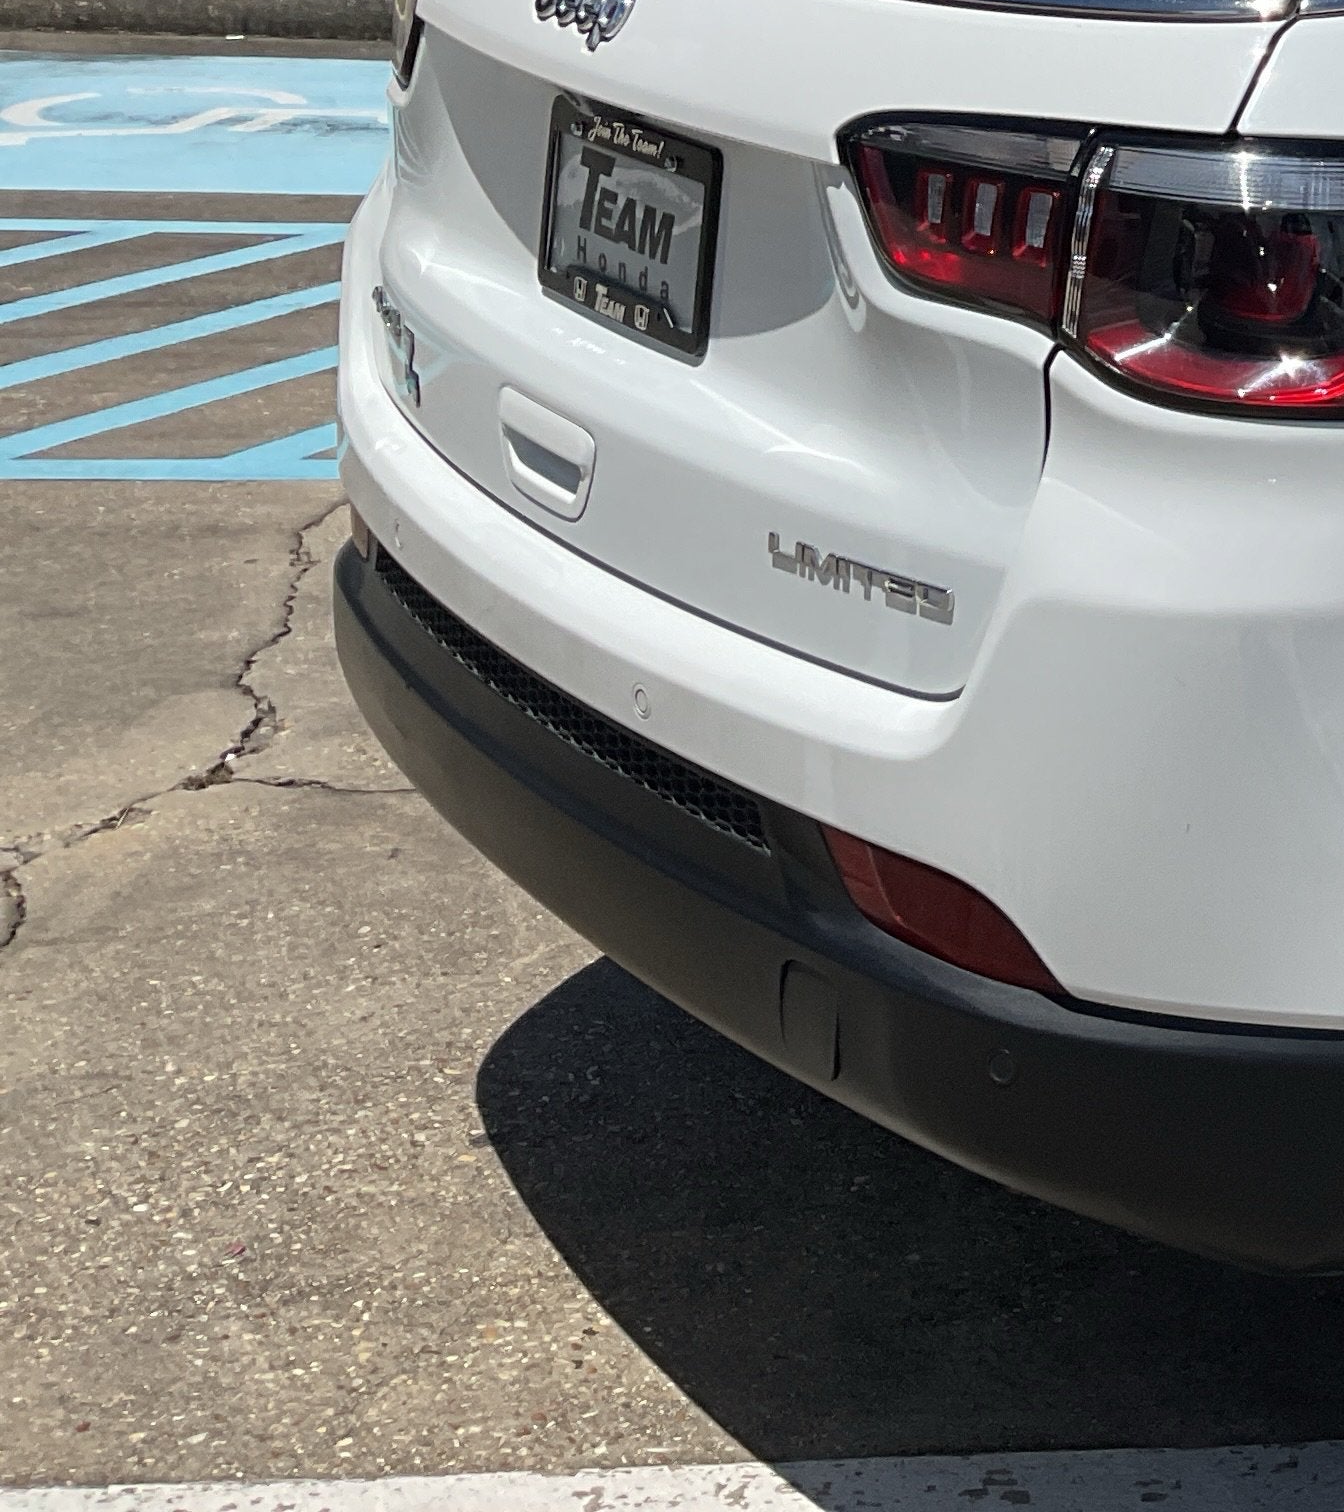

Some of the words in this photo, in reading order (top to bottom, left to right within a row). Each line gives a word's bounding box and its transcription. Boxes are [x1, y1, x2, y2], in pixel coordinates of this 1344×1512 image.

[587, 116, 612, 142] Join
[613, 122, 630, 147] The
[632, 129, 665, 159] Team!
[579, 145, 676, 265] TEAM
[577, 234, 670, 300] Honda
[595, 284, 627, 322] TEAM
[768, 532, 955, 626] LIMITED
